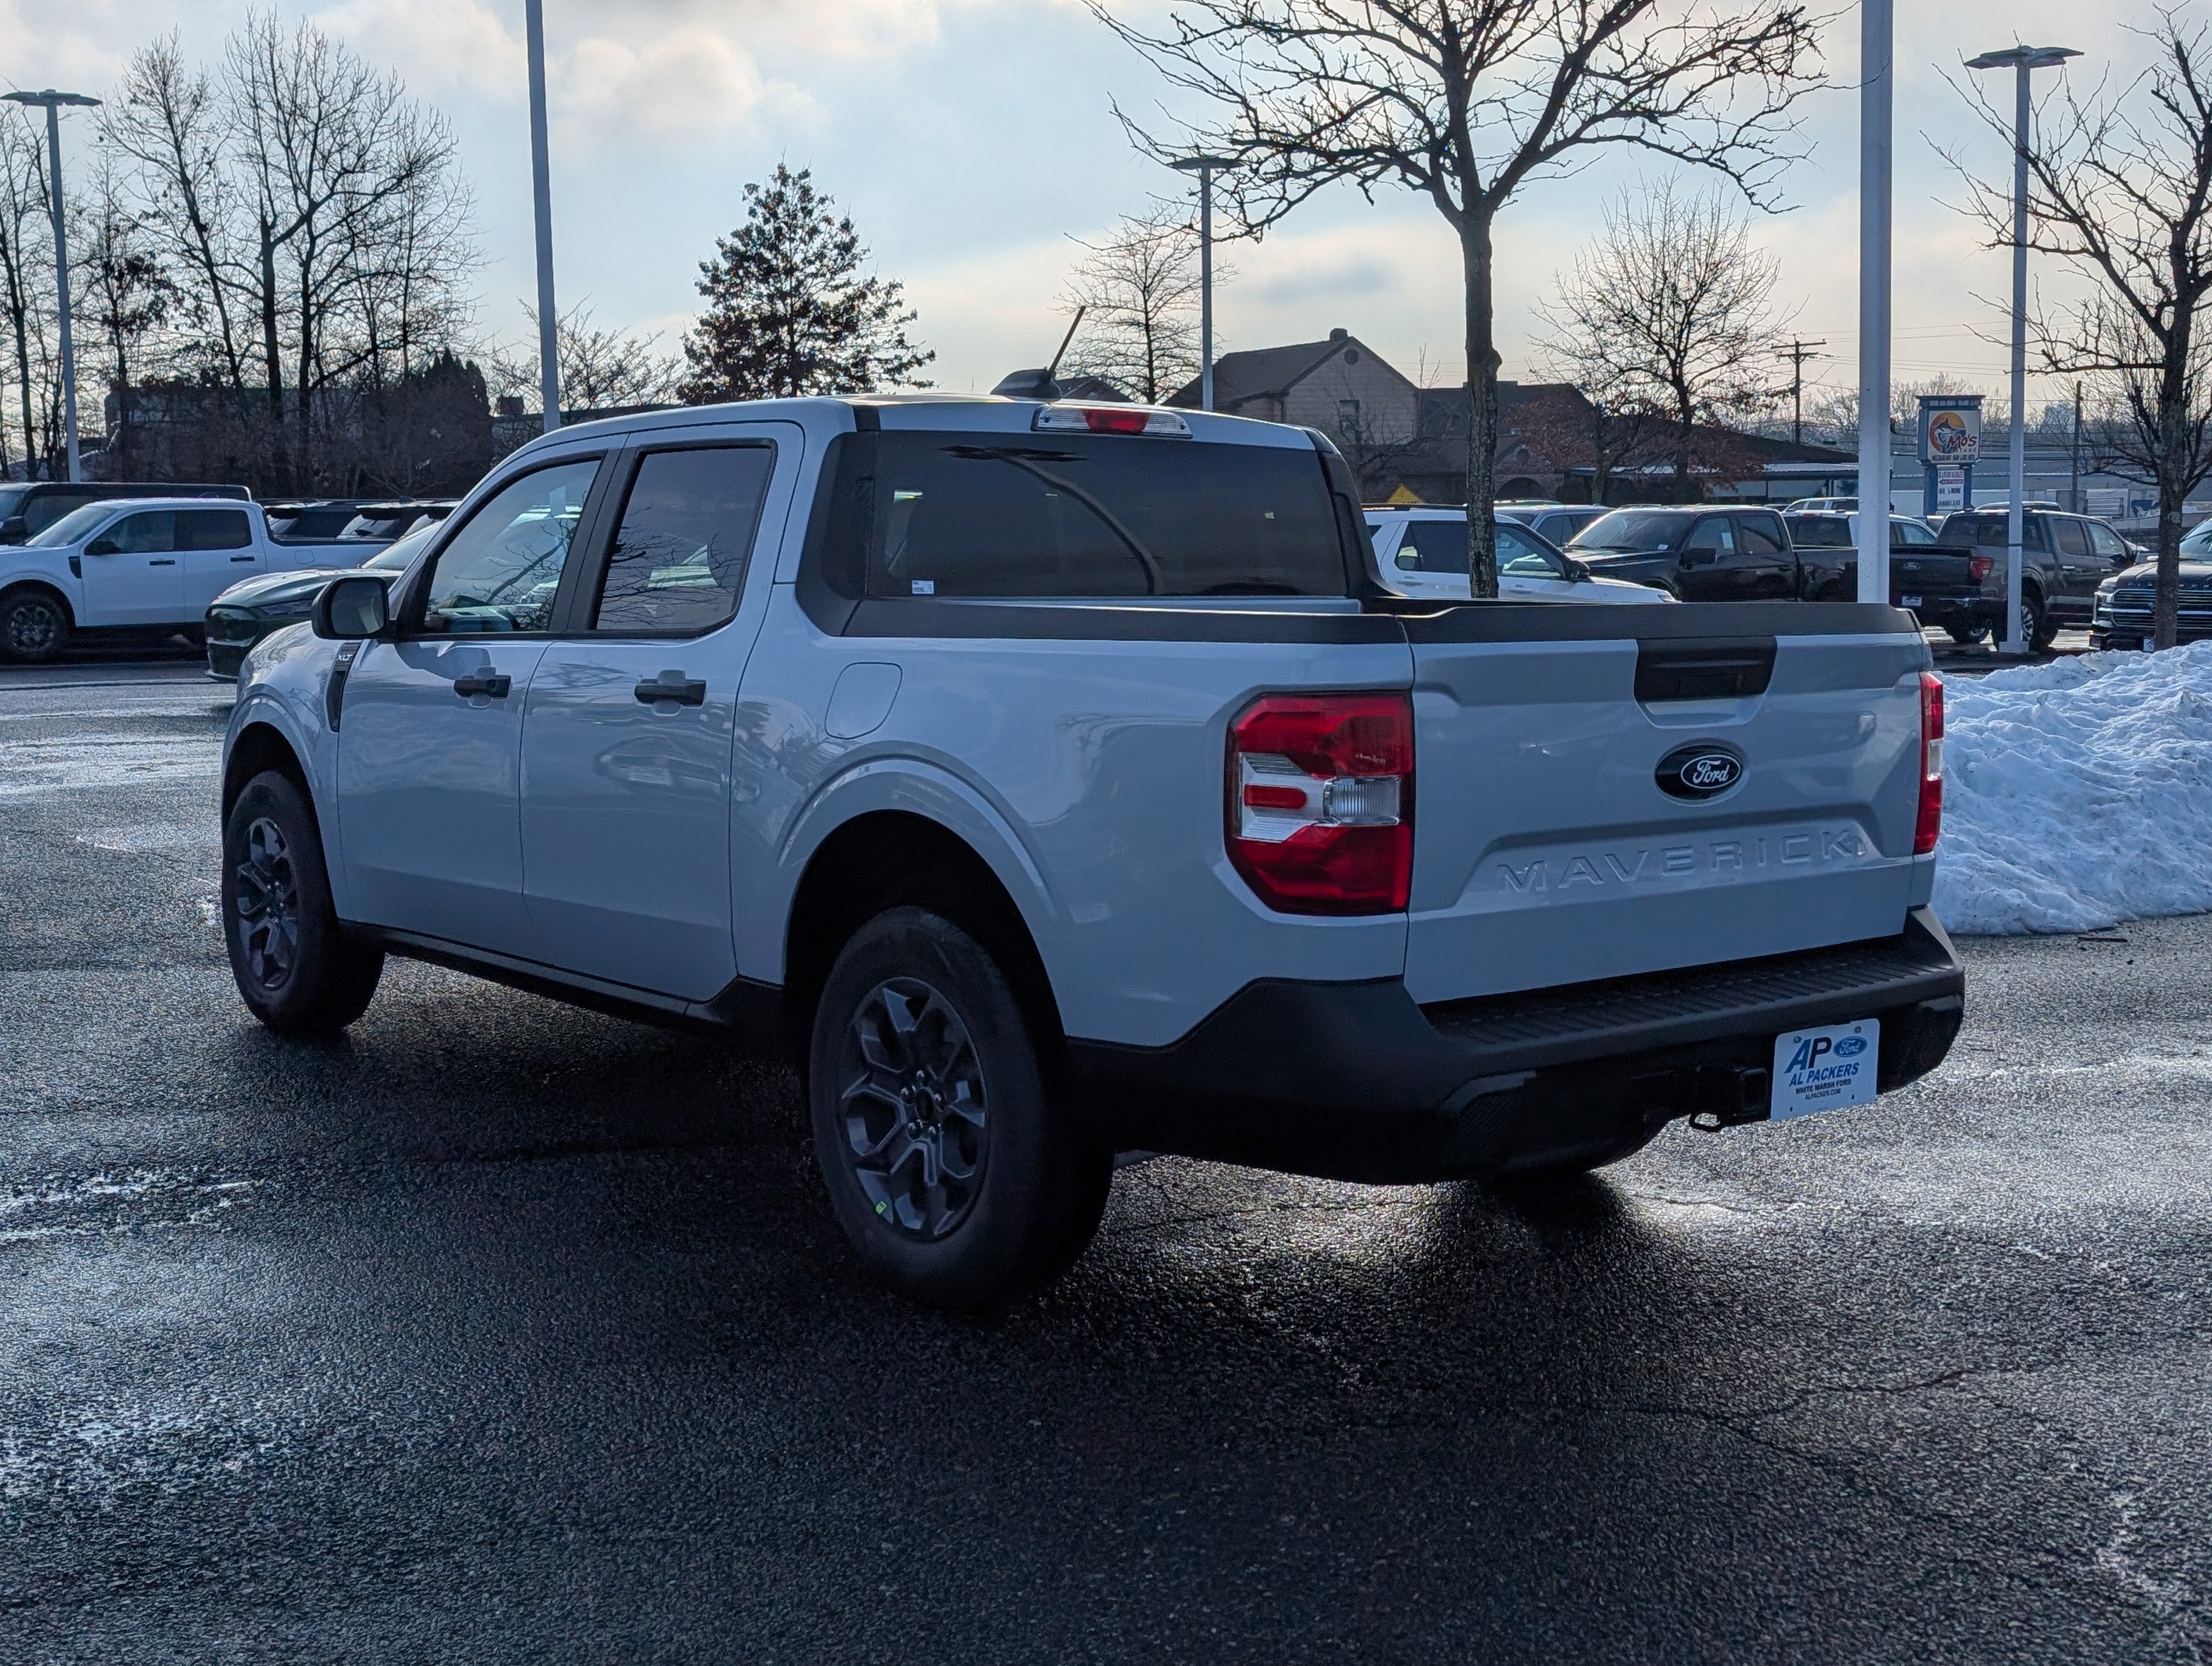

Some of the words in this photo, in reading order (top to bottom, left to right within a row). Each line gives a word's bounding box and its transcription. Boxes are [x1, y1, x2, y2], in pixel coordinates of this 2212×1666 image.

[1693, 760, 1730, 784] Ford
[1497, 829, 1850, 895] MAVERICK
[1784, 1036, 1832, 1074] AP
[1839, 1039, 1861, 1055] Ford
[1789, 1072, 1803, 1087] AL
[1806, 1062, 1860, 1084] PACKERS
[1795, 1085, 1814, 1095] WHITE
[1815, 1081, 1835, 1091] MARSH
[1836, 1078, 1851, 1087] FORD
